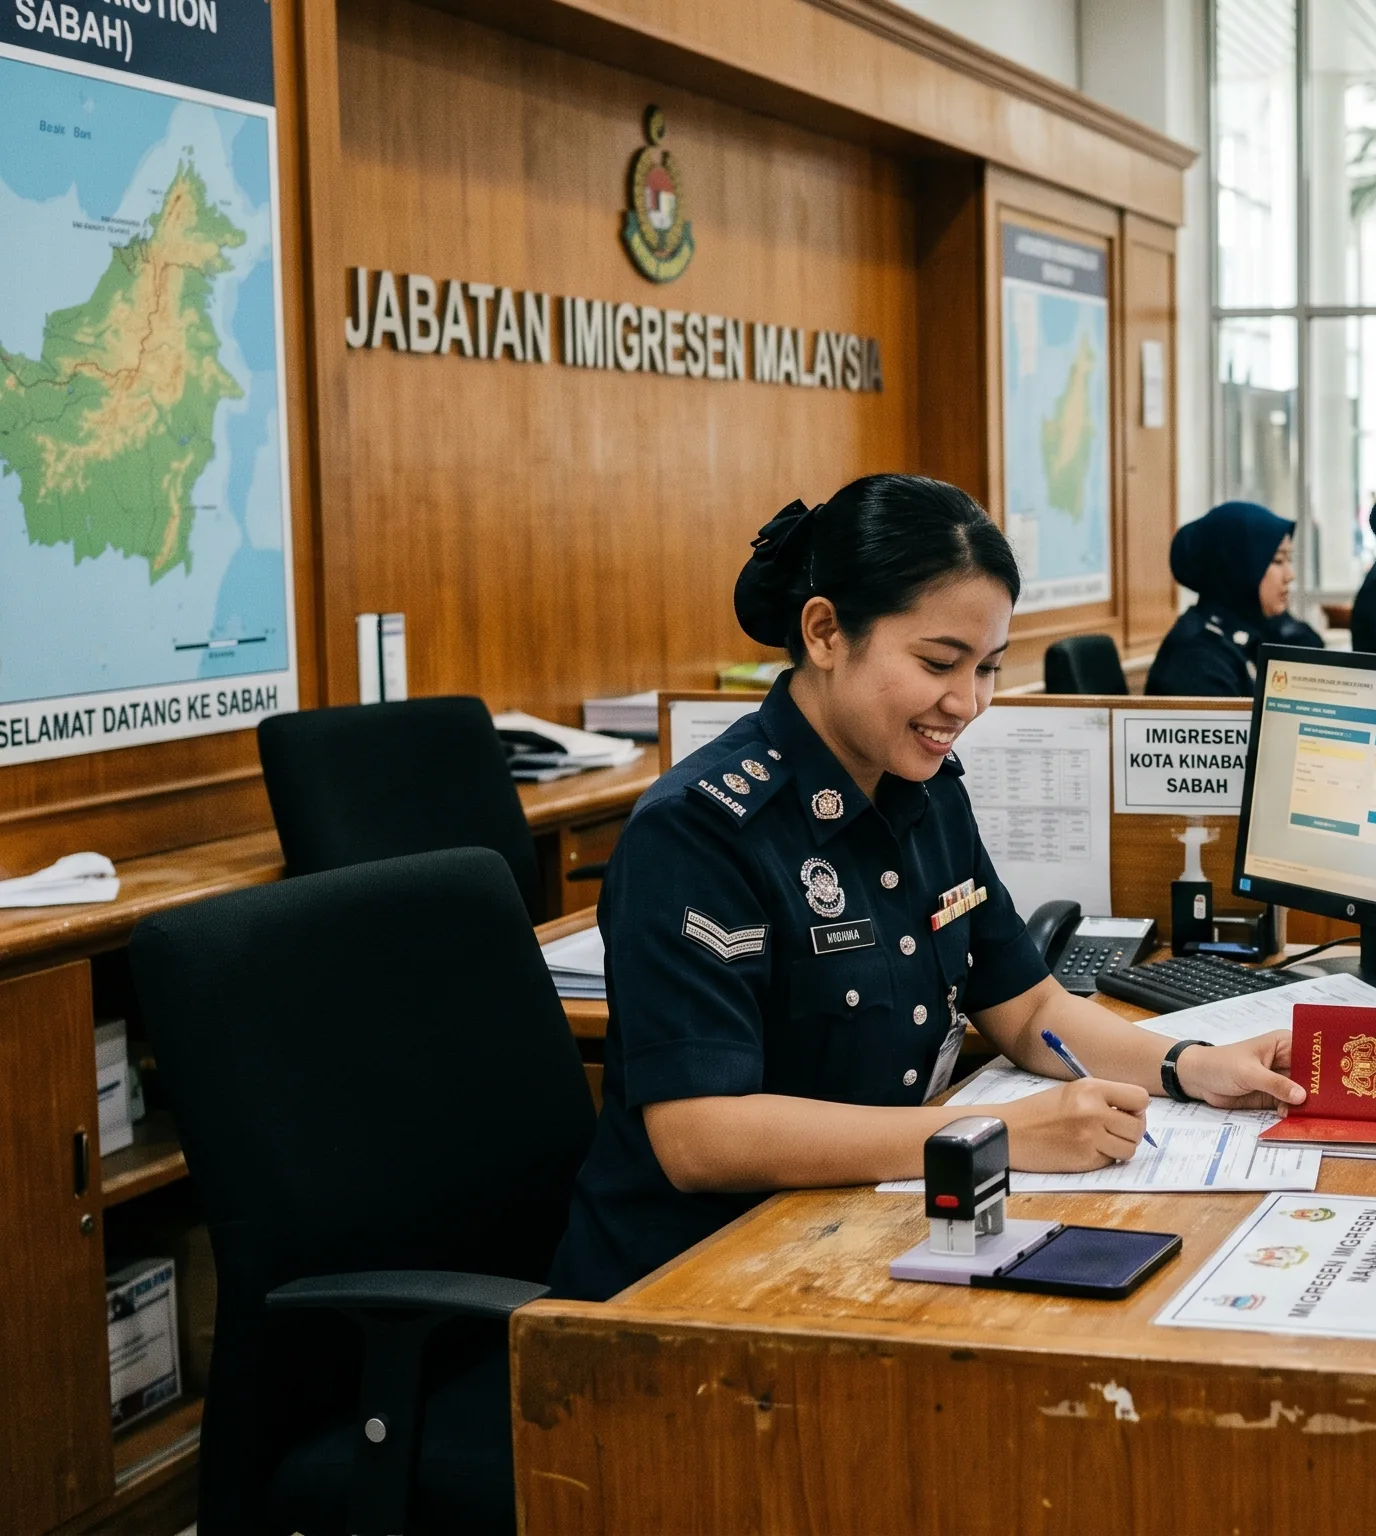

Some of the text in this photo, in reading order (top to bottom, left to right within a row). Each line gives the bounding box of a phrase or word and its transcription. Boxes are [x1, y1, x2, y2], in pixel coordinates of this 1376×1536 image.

[16, 0, 133, 62] SABAH)
[346, 267, 884, 392] JABATAN IMIGRESEN MALAYSIA
[0, 685, 278, 748] SELAMAT DATANG KE SABAH
[1146, 728, 1248, 745] IMIGRESEN
[1130, 753, 1174, 768] KOTA
[1166, 778, 1228, 793] SABAH
